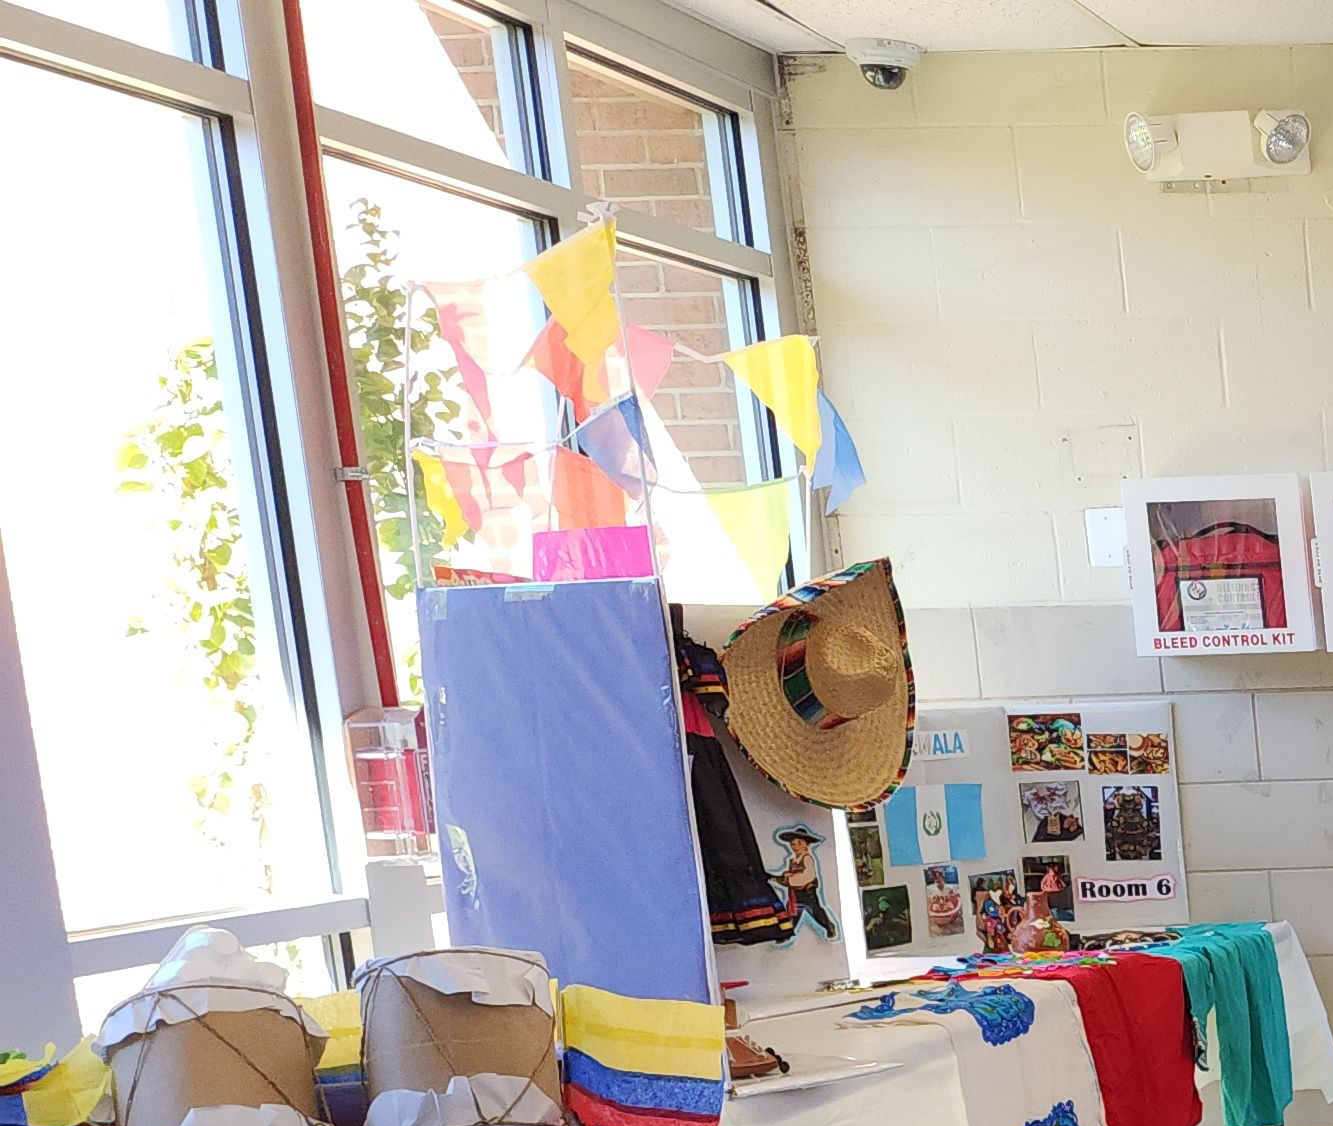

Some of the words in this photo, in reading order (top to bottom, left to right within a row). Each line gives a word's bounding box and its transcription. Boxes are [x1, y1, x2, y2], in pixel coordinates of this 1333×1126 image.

[1153, 636, 1198, 651] BLEED
[1202, 633, 1268, 648] CONTROL
[1271, 632, 1296, 646] KIT
[1080, 879, 1148, 899] Room
[1156, 878, 1172, 896] 6
